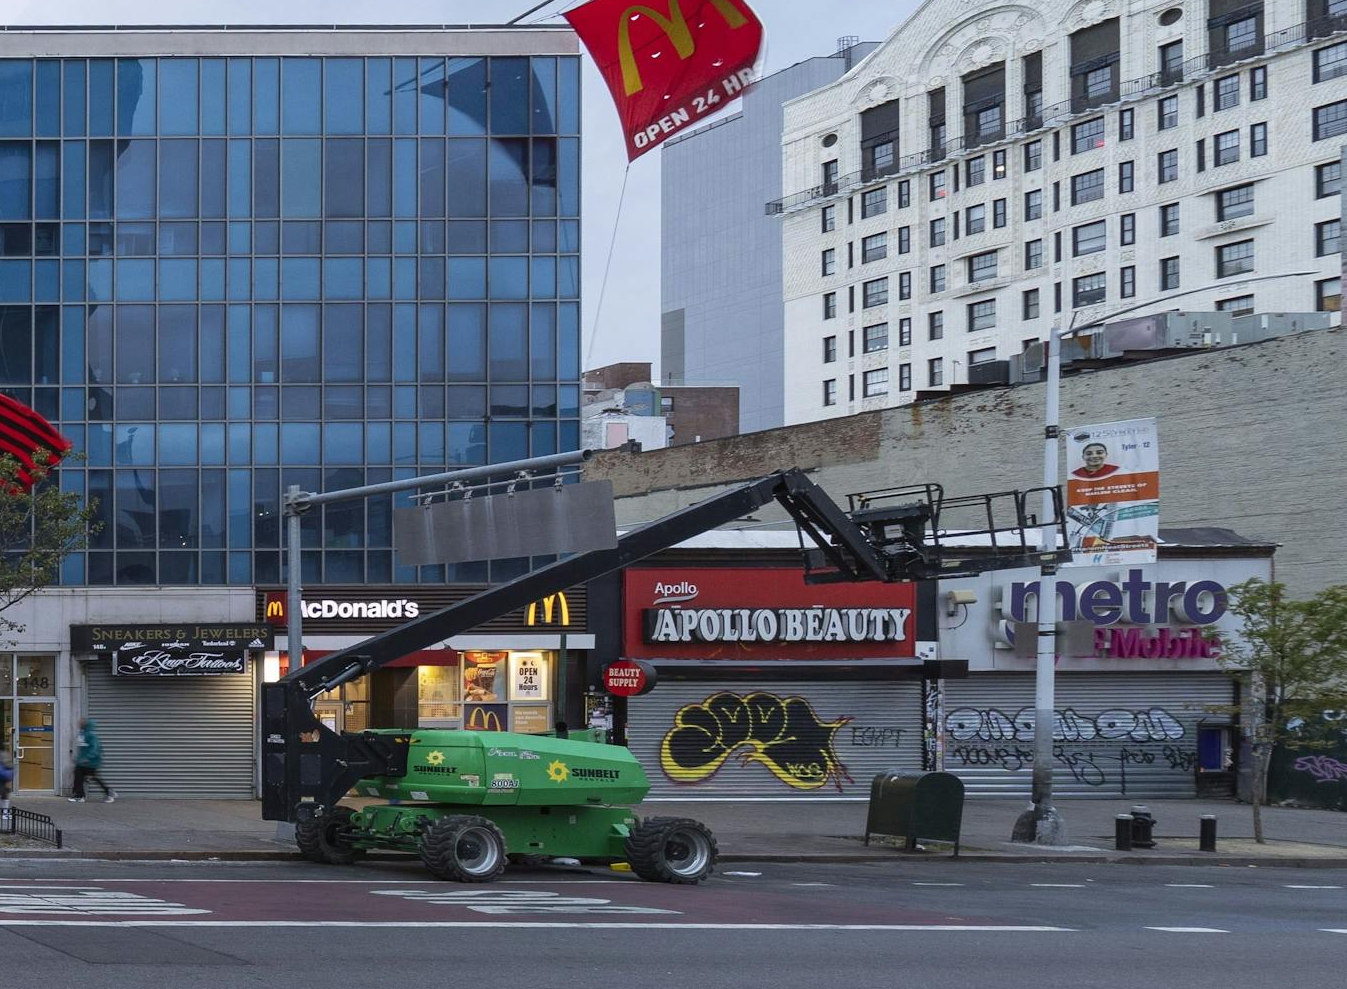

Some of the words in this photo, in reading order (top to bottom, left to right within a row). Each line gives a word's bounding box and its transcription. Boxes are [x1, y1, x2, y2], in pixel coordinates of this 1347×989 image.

[633, 107, 690, 149] OPEN
[692, 88, 721, 114] 24
[654, 582, 697, 597] Apollo
[1010, 568, 1228, 625] metro
[653, 608, 778, 642] APOLLO
[785, 608, 910, 642] BEAUTY
[92, 628, 170, 641] SNEAKERS
[176, 628, 186, 639] &
[192, 626, 268, 640] JEWELERS
[519, 668, 538, 676] OPEN
[608, 668, 641, 678] BEAUTY
[22, 677, 49, 689] 148
[524, 676, 533, 684] 24
[608, 678, 638, 688] SUPPLY
[572, 768, 620, 779] SUNBELT
